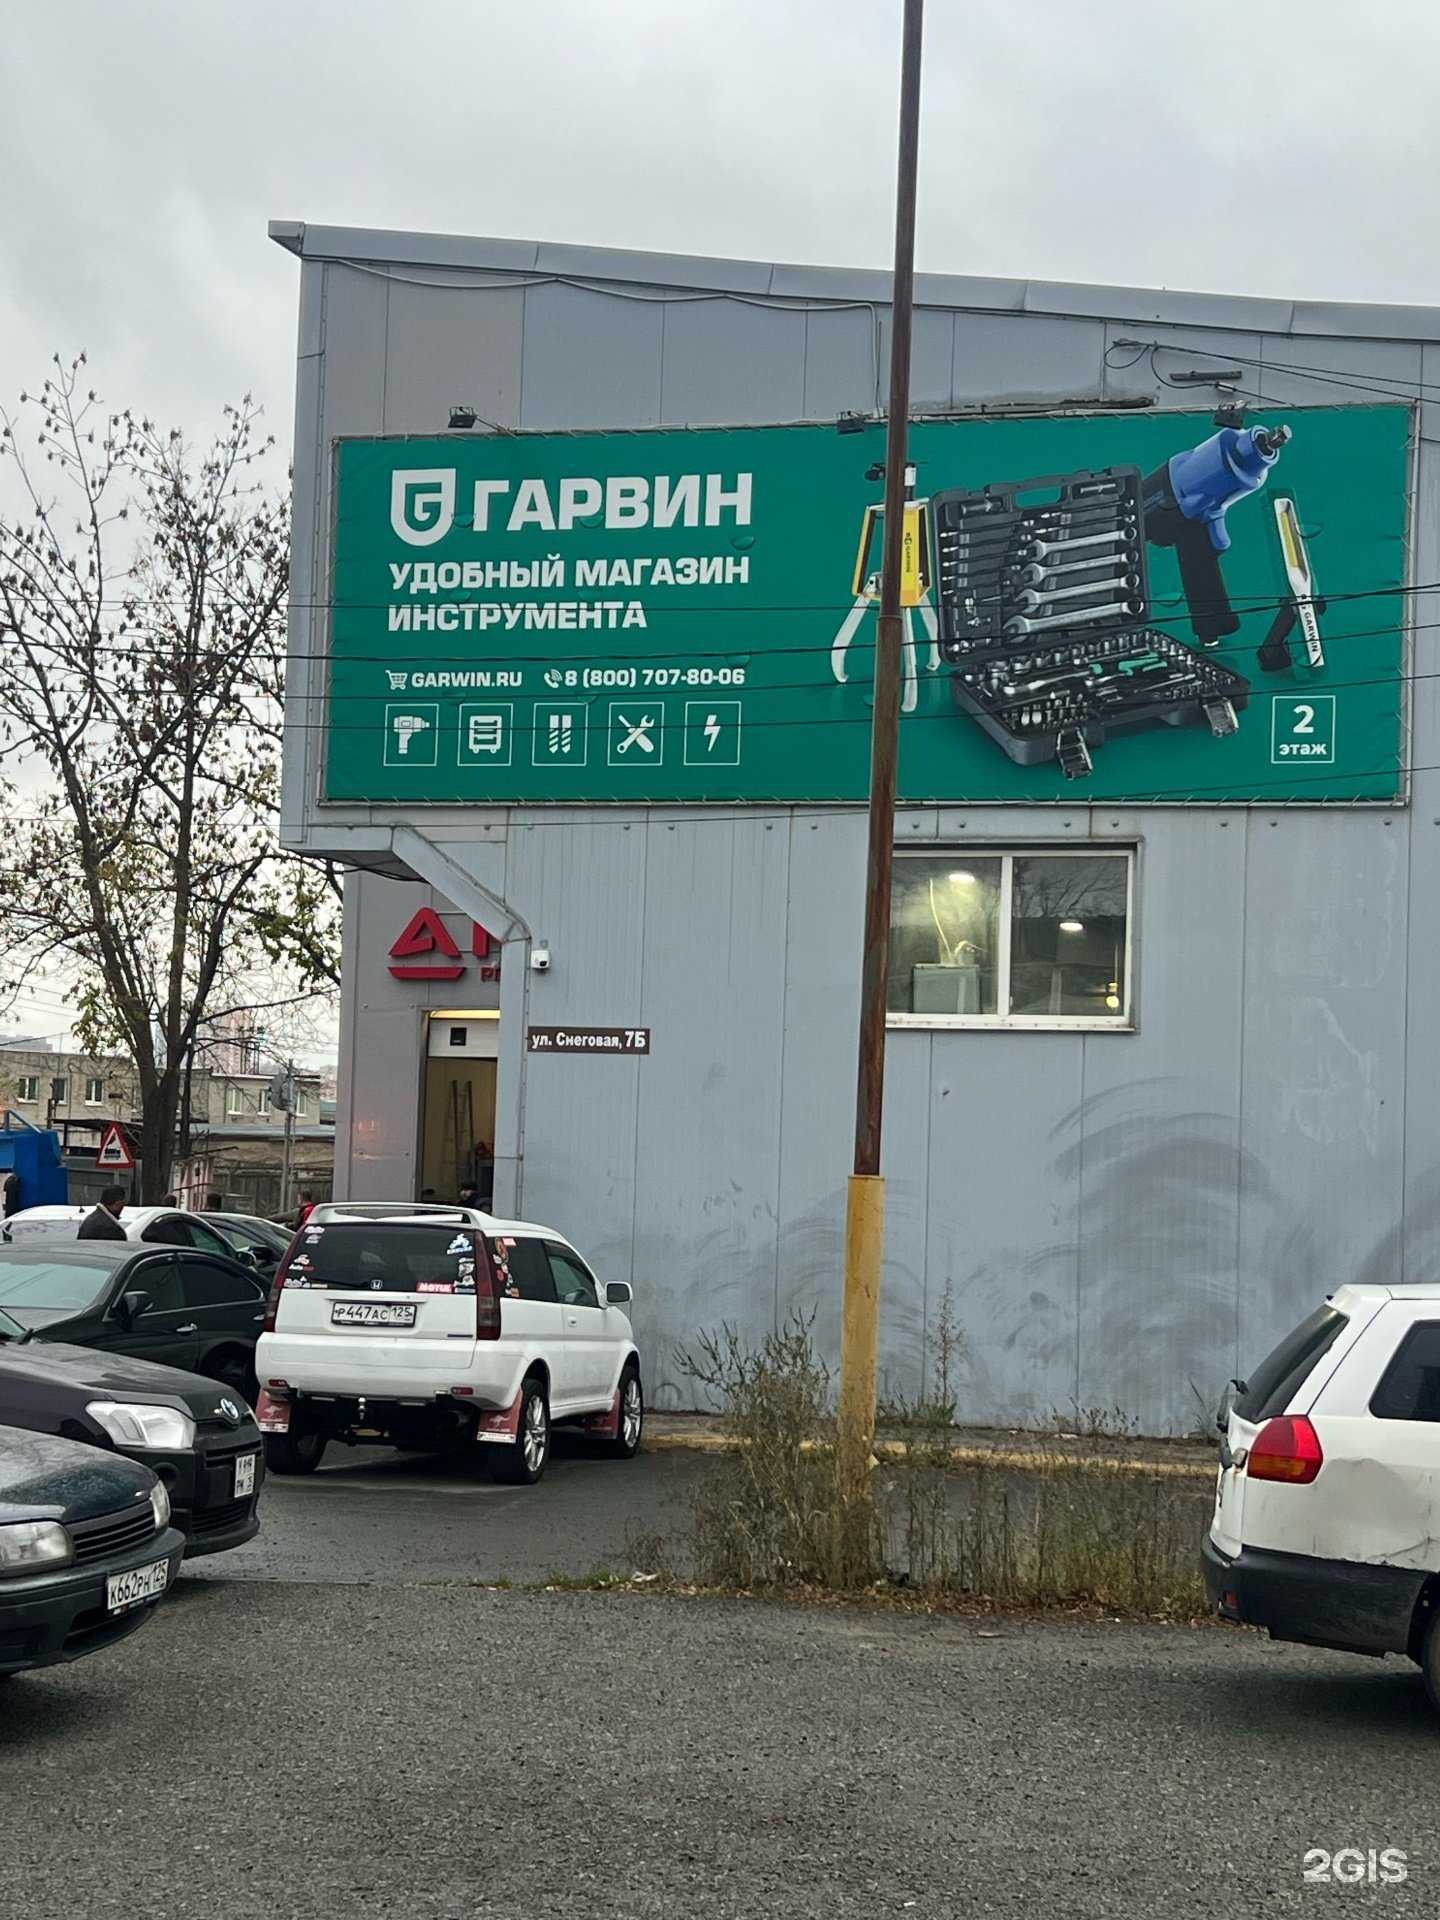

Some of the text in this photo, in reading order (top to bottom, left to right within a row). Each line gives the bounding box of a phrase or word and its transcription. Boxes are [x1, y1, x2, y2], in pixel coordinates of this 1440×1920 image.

[472, 473, 753, 532] ГАРВИН
[388, 553, 750, 595] УДОБНЫЙ МАГАЗИН
[387, 600, 648, 632] ИНСТРУМЕНТА
[411, 670, 523, 688] GARWIN.RU
[564, 668, 746, 688] 8 (800) 707-80-06
[1293, 704, 1314, 734] 2
[1279, 743, 1328, 756] этаж
[531, 1030, 646, 1050] ул. Снеговая, 7Б
